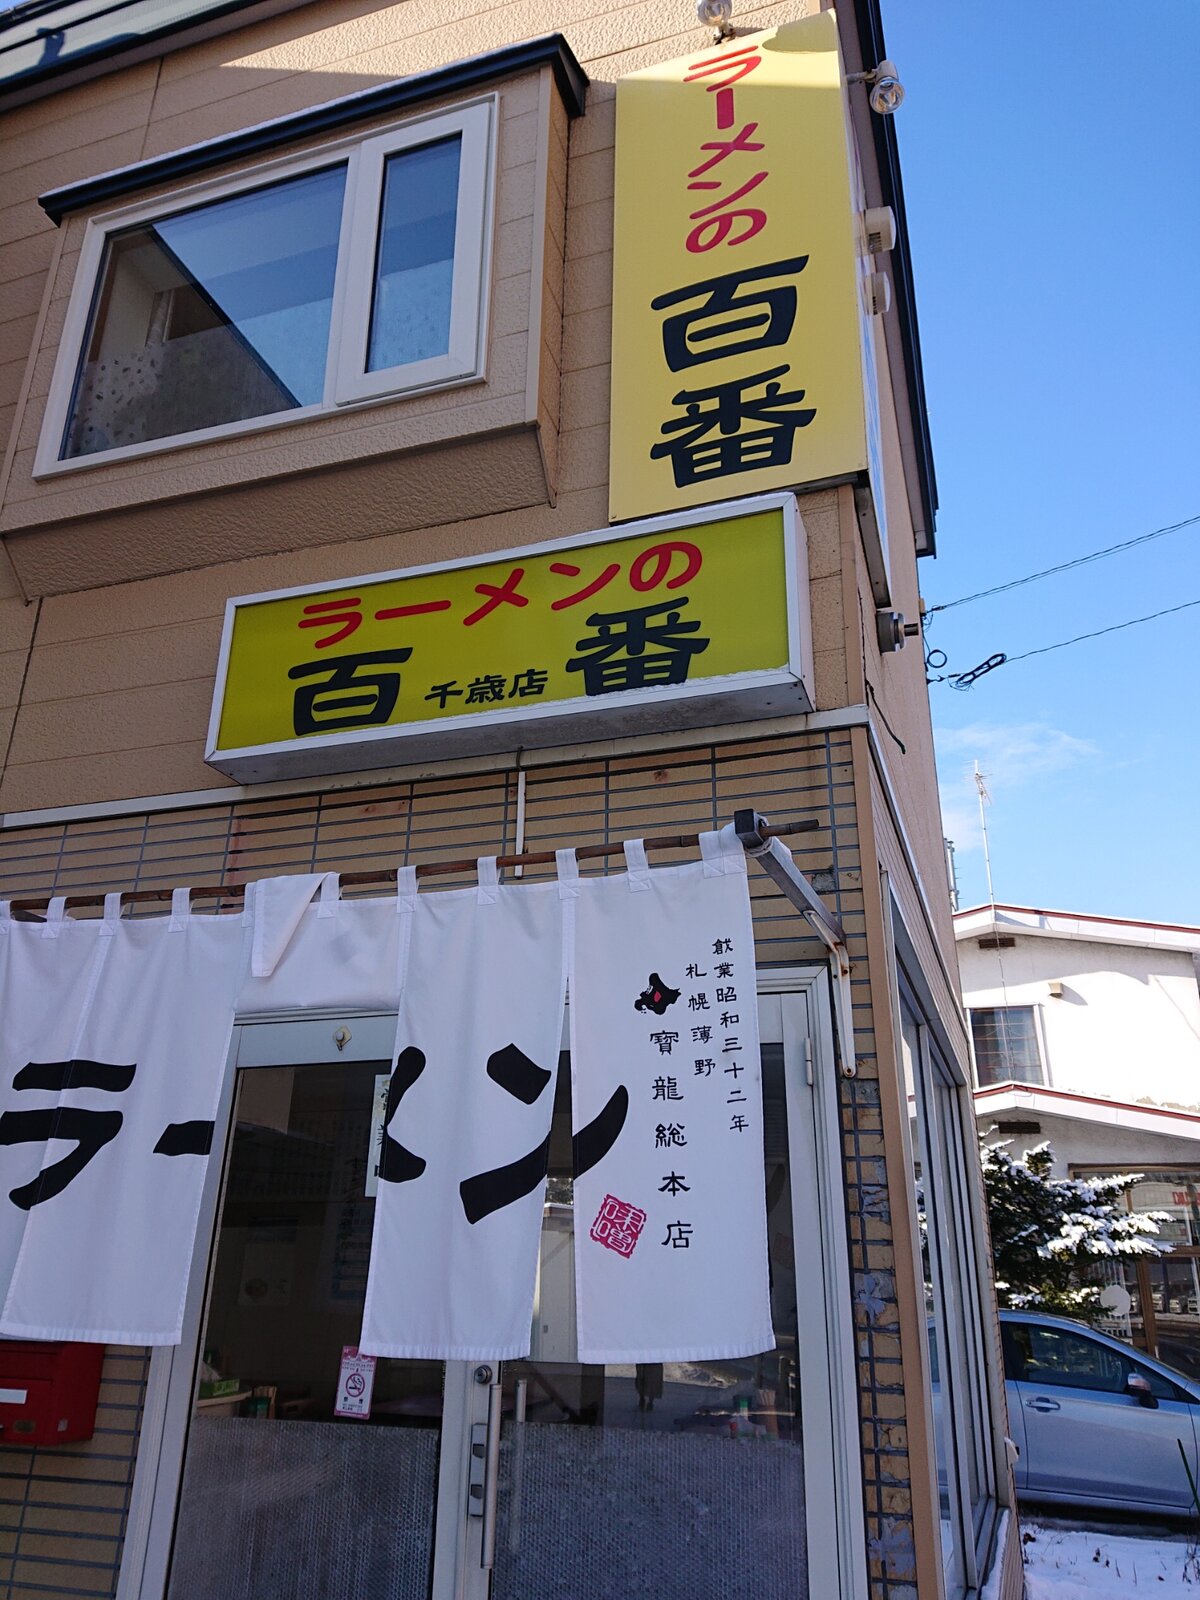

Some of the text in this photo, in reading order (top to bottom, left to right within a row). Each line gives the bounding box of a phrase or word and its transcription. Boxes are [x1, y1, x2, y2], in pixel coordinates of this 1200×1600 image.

[683, 45, 769, 254] ラーメンの
[650, 254, 817, 488] 百番
[298, 541, 703, 649] ラーメンの
[288, 596, 710, 736] 百 番
[424, 668, 549, 709] 千歳店
[685, 963, 716, 1077] 札幌薄野
